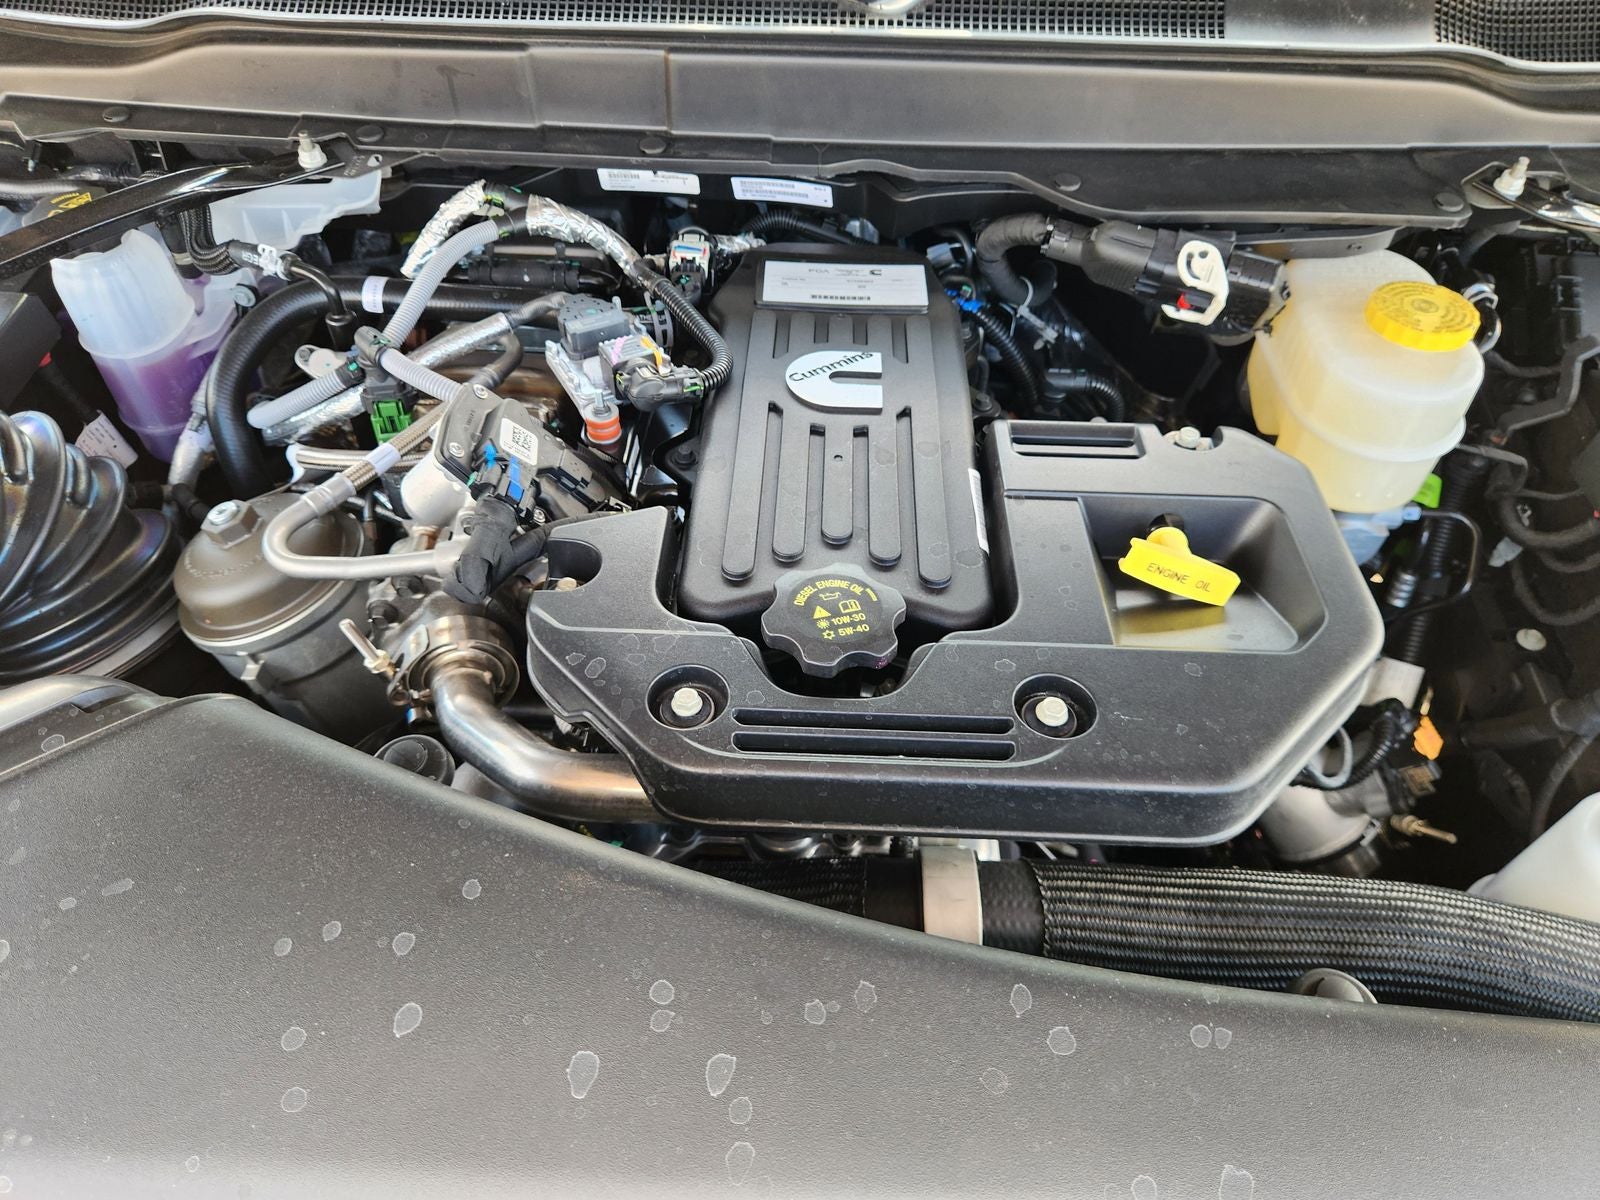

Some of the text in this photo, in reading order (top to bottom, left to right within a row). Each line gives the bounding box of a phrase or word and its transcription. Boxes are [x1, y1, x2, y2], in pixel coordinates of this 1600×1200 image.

[788, 351, 874, 382] Cummins
[1146, 562, 1211, 593] ENGINE OIL
[793, 579, 864, 606] DIESEL ENGINE OIL
[831, 612, 866, 626] 10W-30
[838, 623, 870, 637] 5W-40
